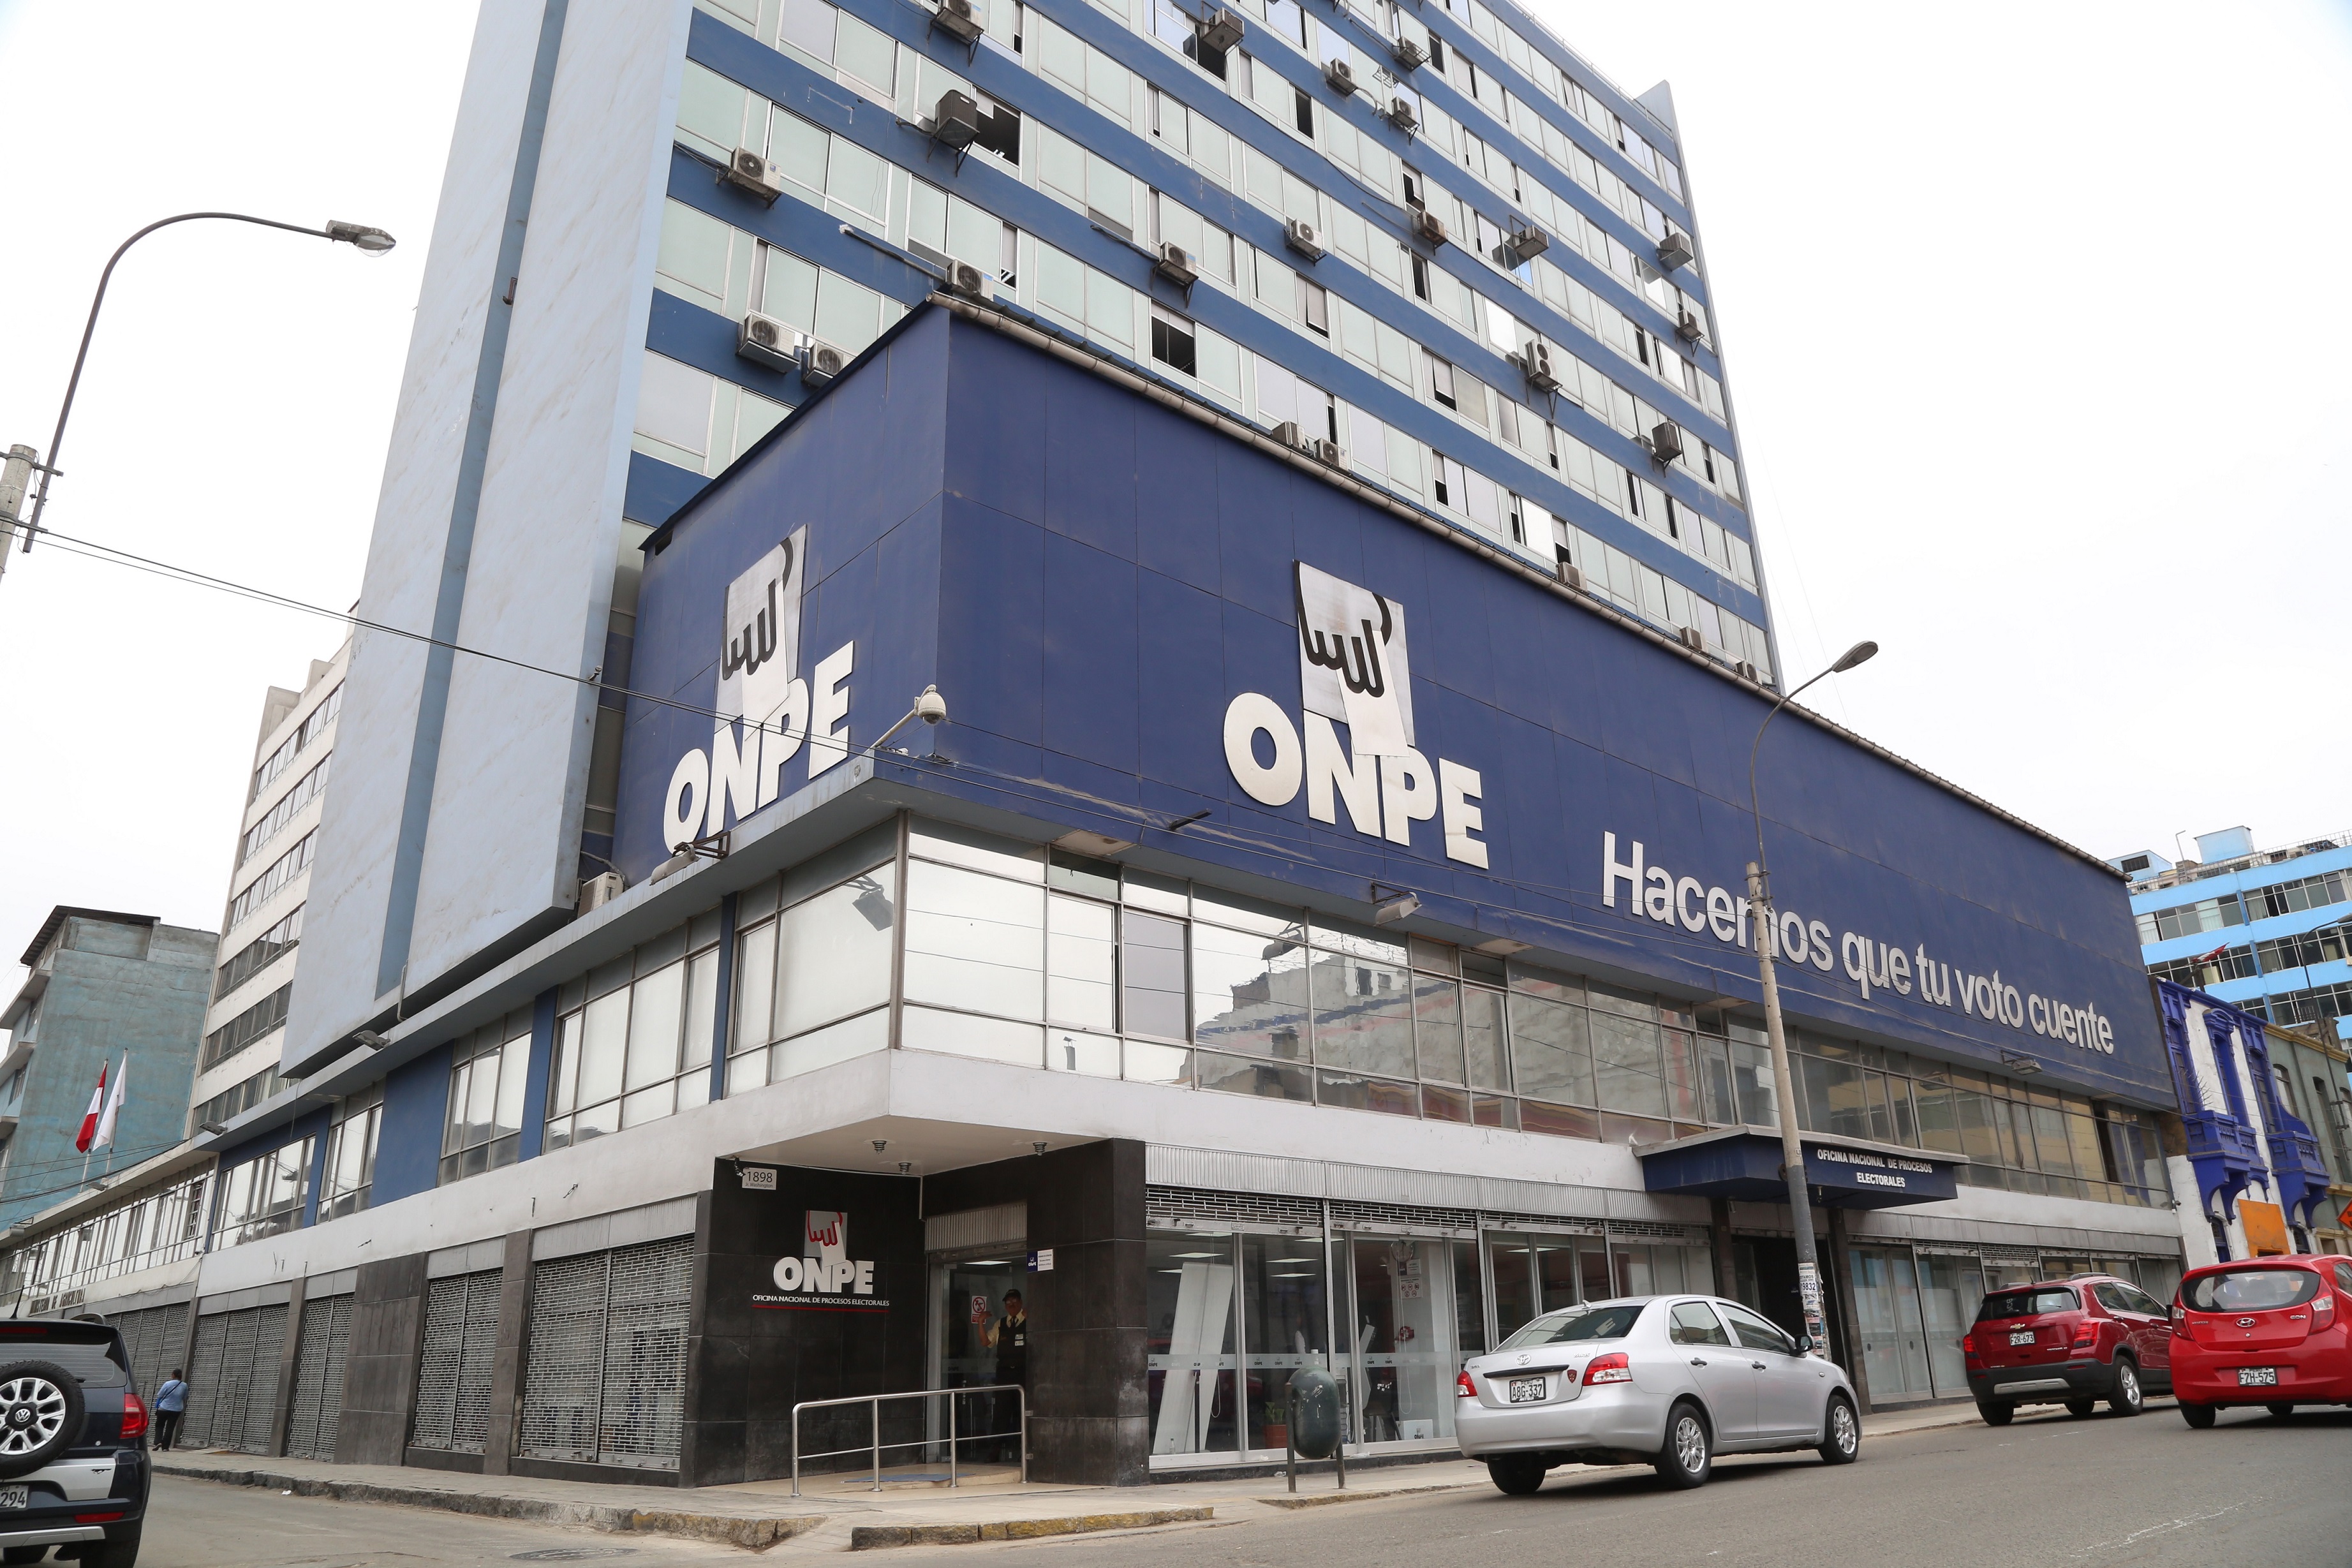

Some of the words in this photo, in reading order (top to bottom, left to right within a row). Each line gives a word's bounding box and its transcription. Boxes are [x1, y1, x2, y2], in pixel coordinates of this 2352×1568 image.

[663, 640, 854, 855] ONPE
[1224, 692, 1489, 869] ONPE
[1603, 831, 1834, 972] Hacemos
[1842, 931, 1911, 1000] que
[1915, 943, 1951, 1007] tu
[1955, 969, 2023, 1028] voto
[2029, 1002, 2115, 1055] cuente
[1817, 1149, 1848, 1163] OFICINA
[1849, 1153, 1886, 1167] NACIONAL
[1888, 1158, 1898, 1169] DE
[1898, 1160, 1933, 1174] PROCESOS
[747, 1171, 773, 1183] 1898
[1857, 1172, 1906, 1188] ELECTORALES
[774, 1257, 875, 1294] ONPE
[2010, 1334, 2034, 1344] F2R-673
[2239, 1372, 2275, 1383] F7H-575
[1512, 1384, 1542, 1399] A8G-337
